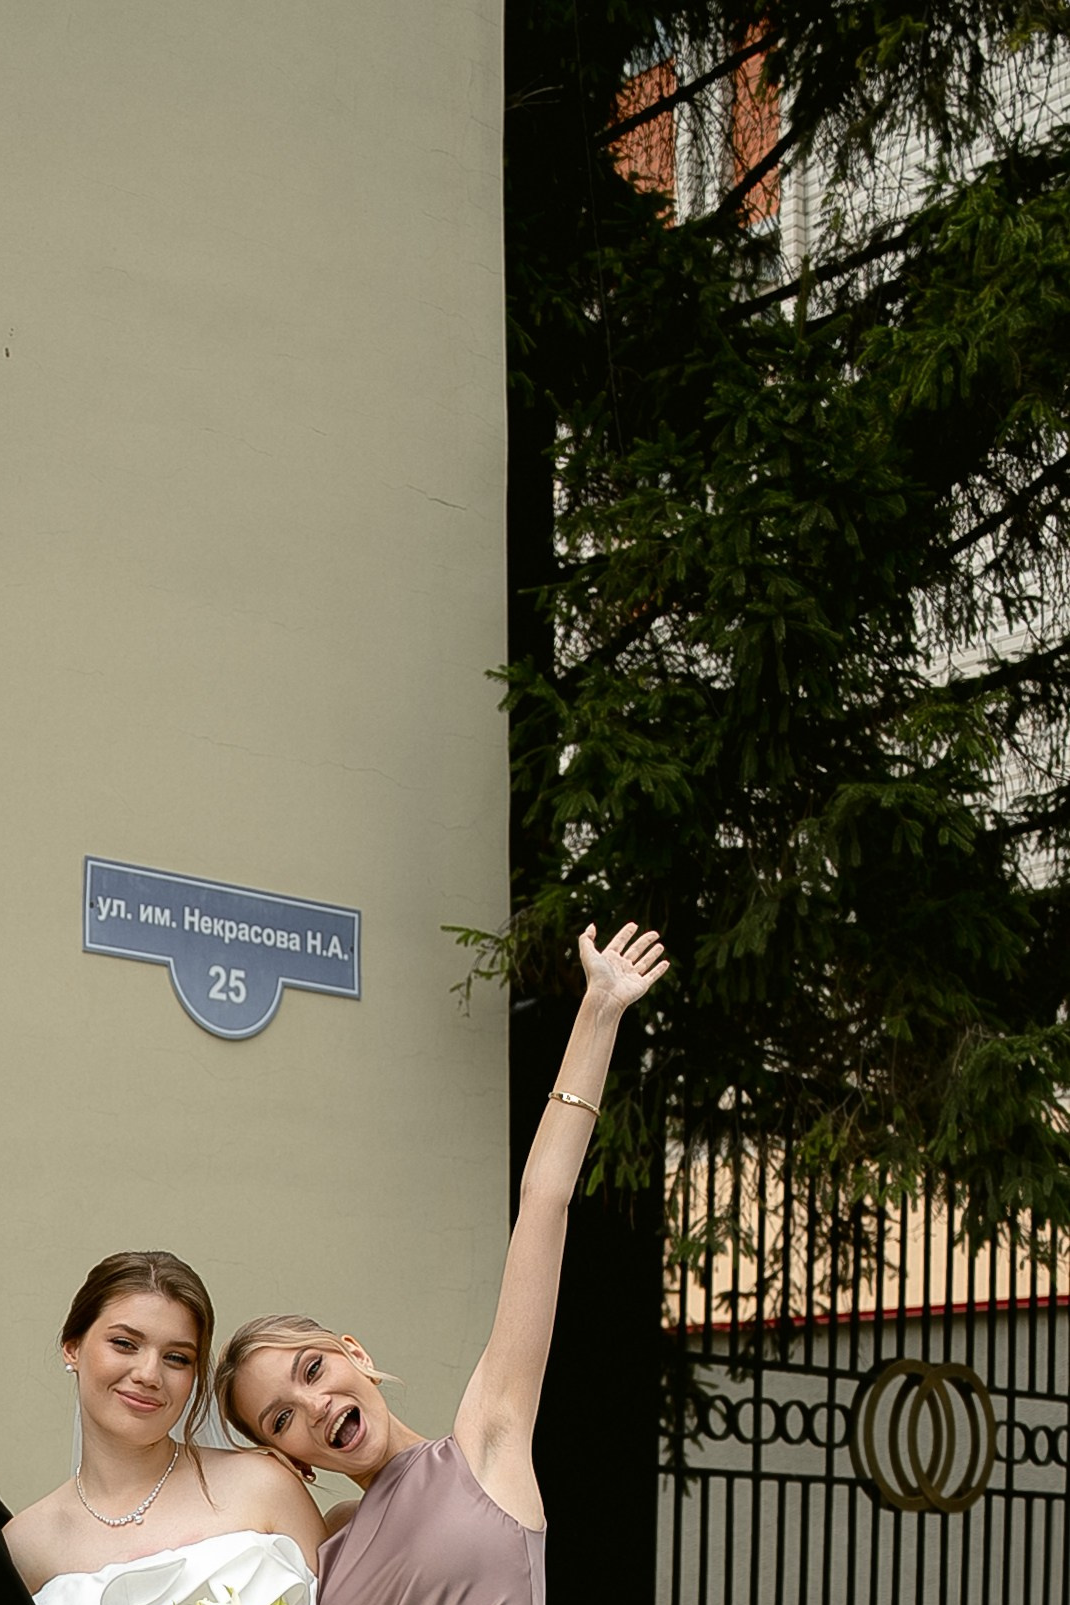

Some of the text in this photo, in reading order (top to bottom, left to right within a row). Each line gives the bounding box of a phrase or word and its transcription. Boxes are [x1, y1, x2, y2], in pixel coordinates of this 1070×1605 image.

[97, 895, 349, 961] ул. им. Некрасова Н.А.
[208, 965, 247, 1003] 25
